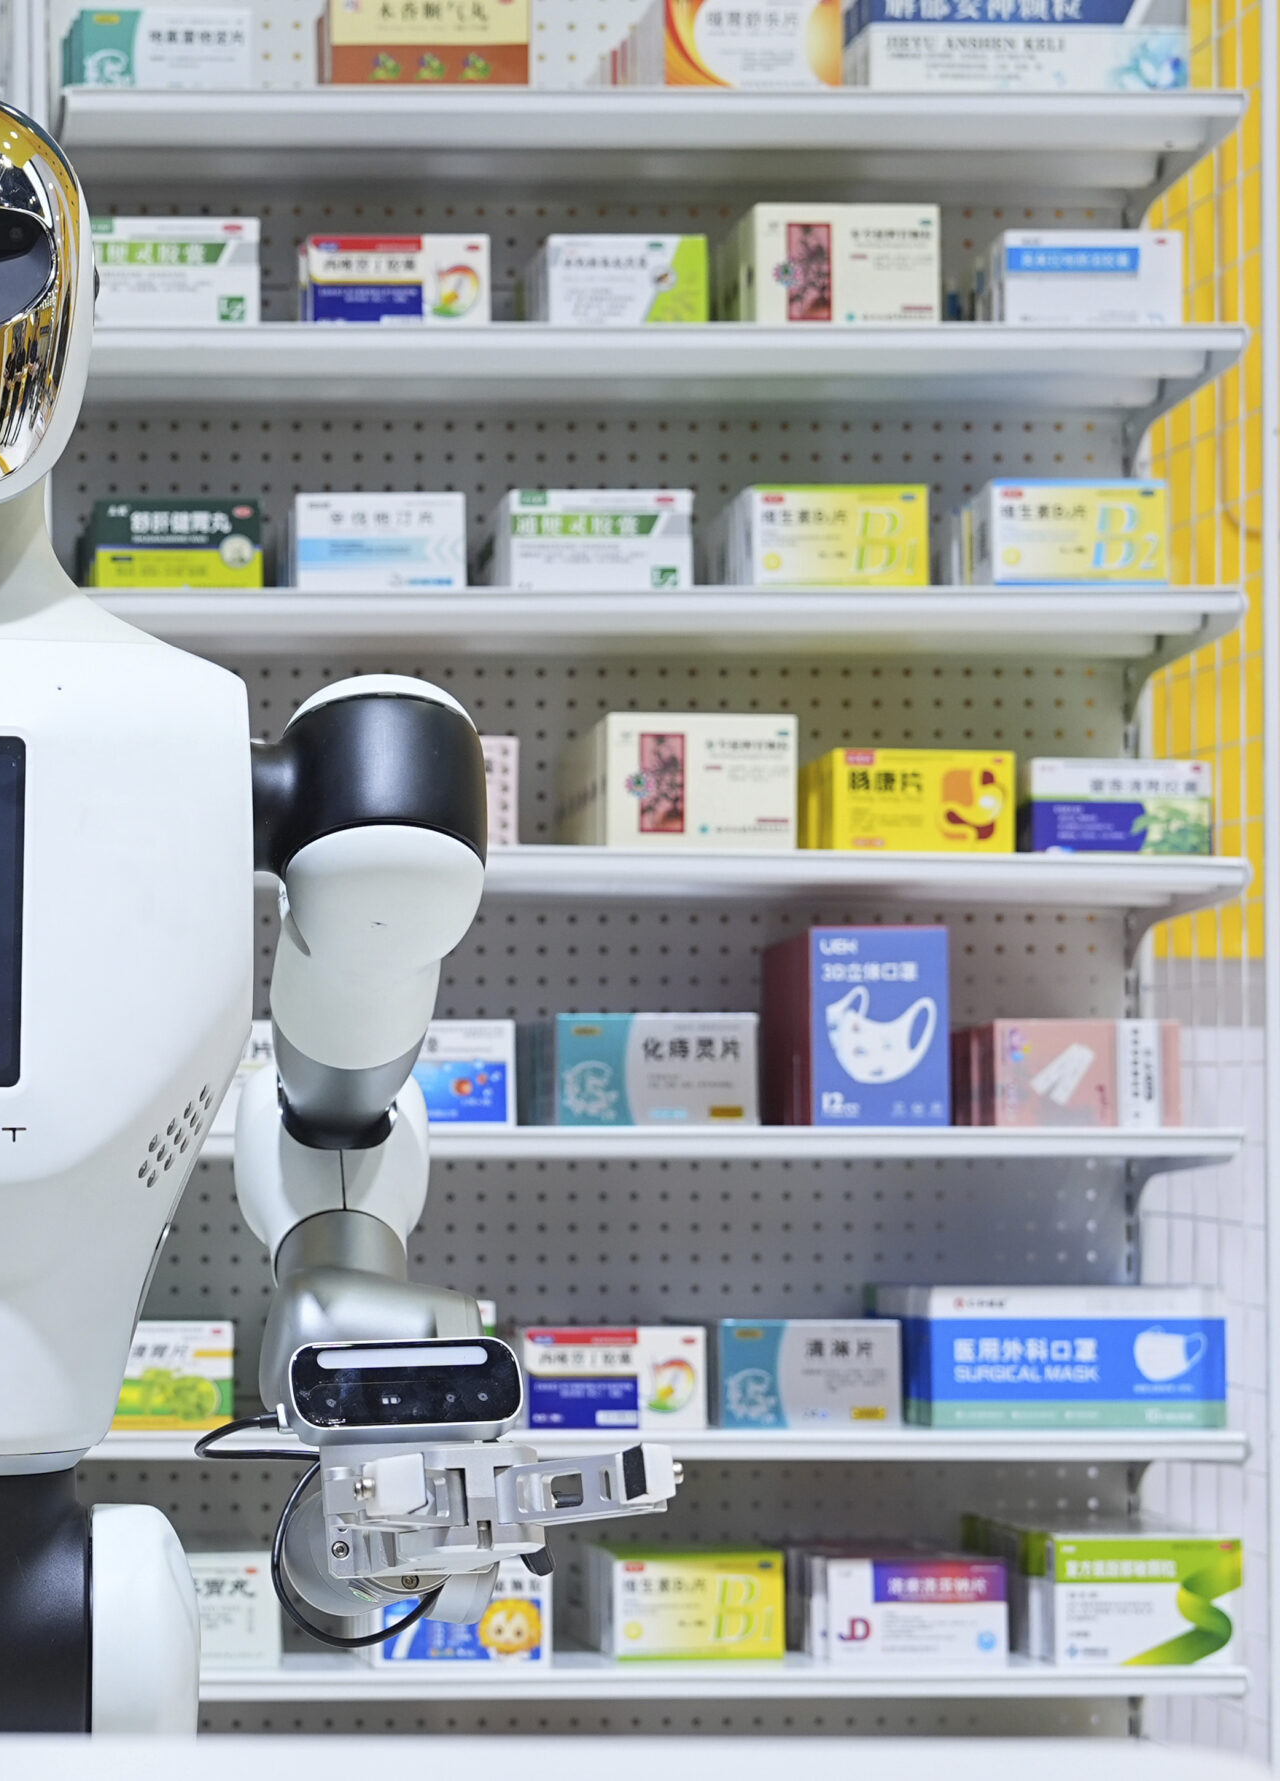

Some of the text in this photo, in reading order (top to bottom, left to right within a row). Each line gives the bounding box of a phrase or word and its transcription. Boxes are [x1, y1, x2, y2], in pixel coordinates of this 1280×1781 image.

[130, 511, 233, 534] 舒肝健胃丸
[848, 770, 923, 793] 肠康片
[641, 1037, 740, 1062] 化痔灵片
[952, 1337, 1098, 1363] 医用外科口罩
[953, 1364, 1100, 1383] SURGICAL MASK
